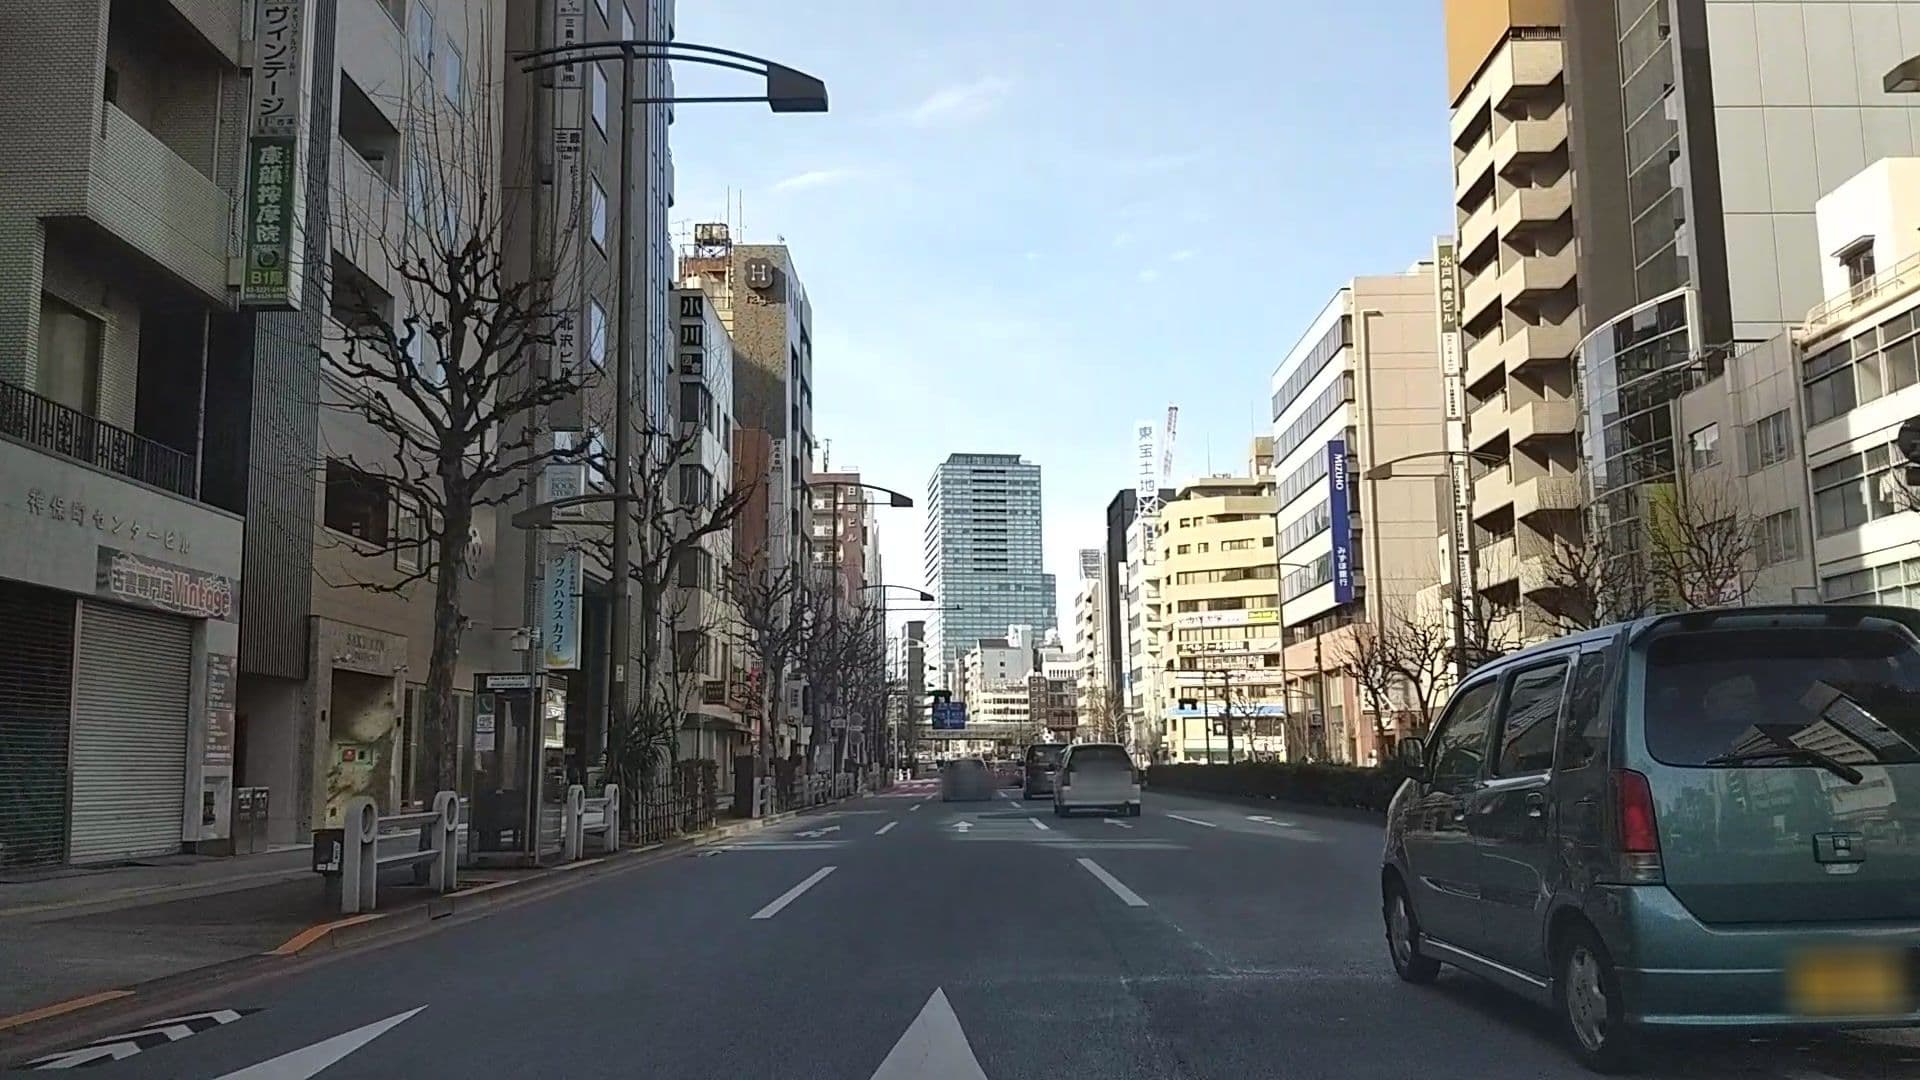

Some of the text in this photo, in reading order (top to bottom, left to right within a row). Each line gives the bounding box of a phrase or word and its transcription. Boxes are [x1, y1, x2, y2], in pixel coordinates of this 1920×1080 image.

[260, 6, 290, 116] ヴィンテージ
[751, 264, 766, 281] H
[558, 319, 574, 378] 北沢ビル
[1335, 453, 1344, 491] MIZUHO
[27, 488, 190, 554] 神保町センタービル
[1338, 546, 1348, 586] みずほ銀行
[173, 570, 233, 617] Vintage
